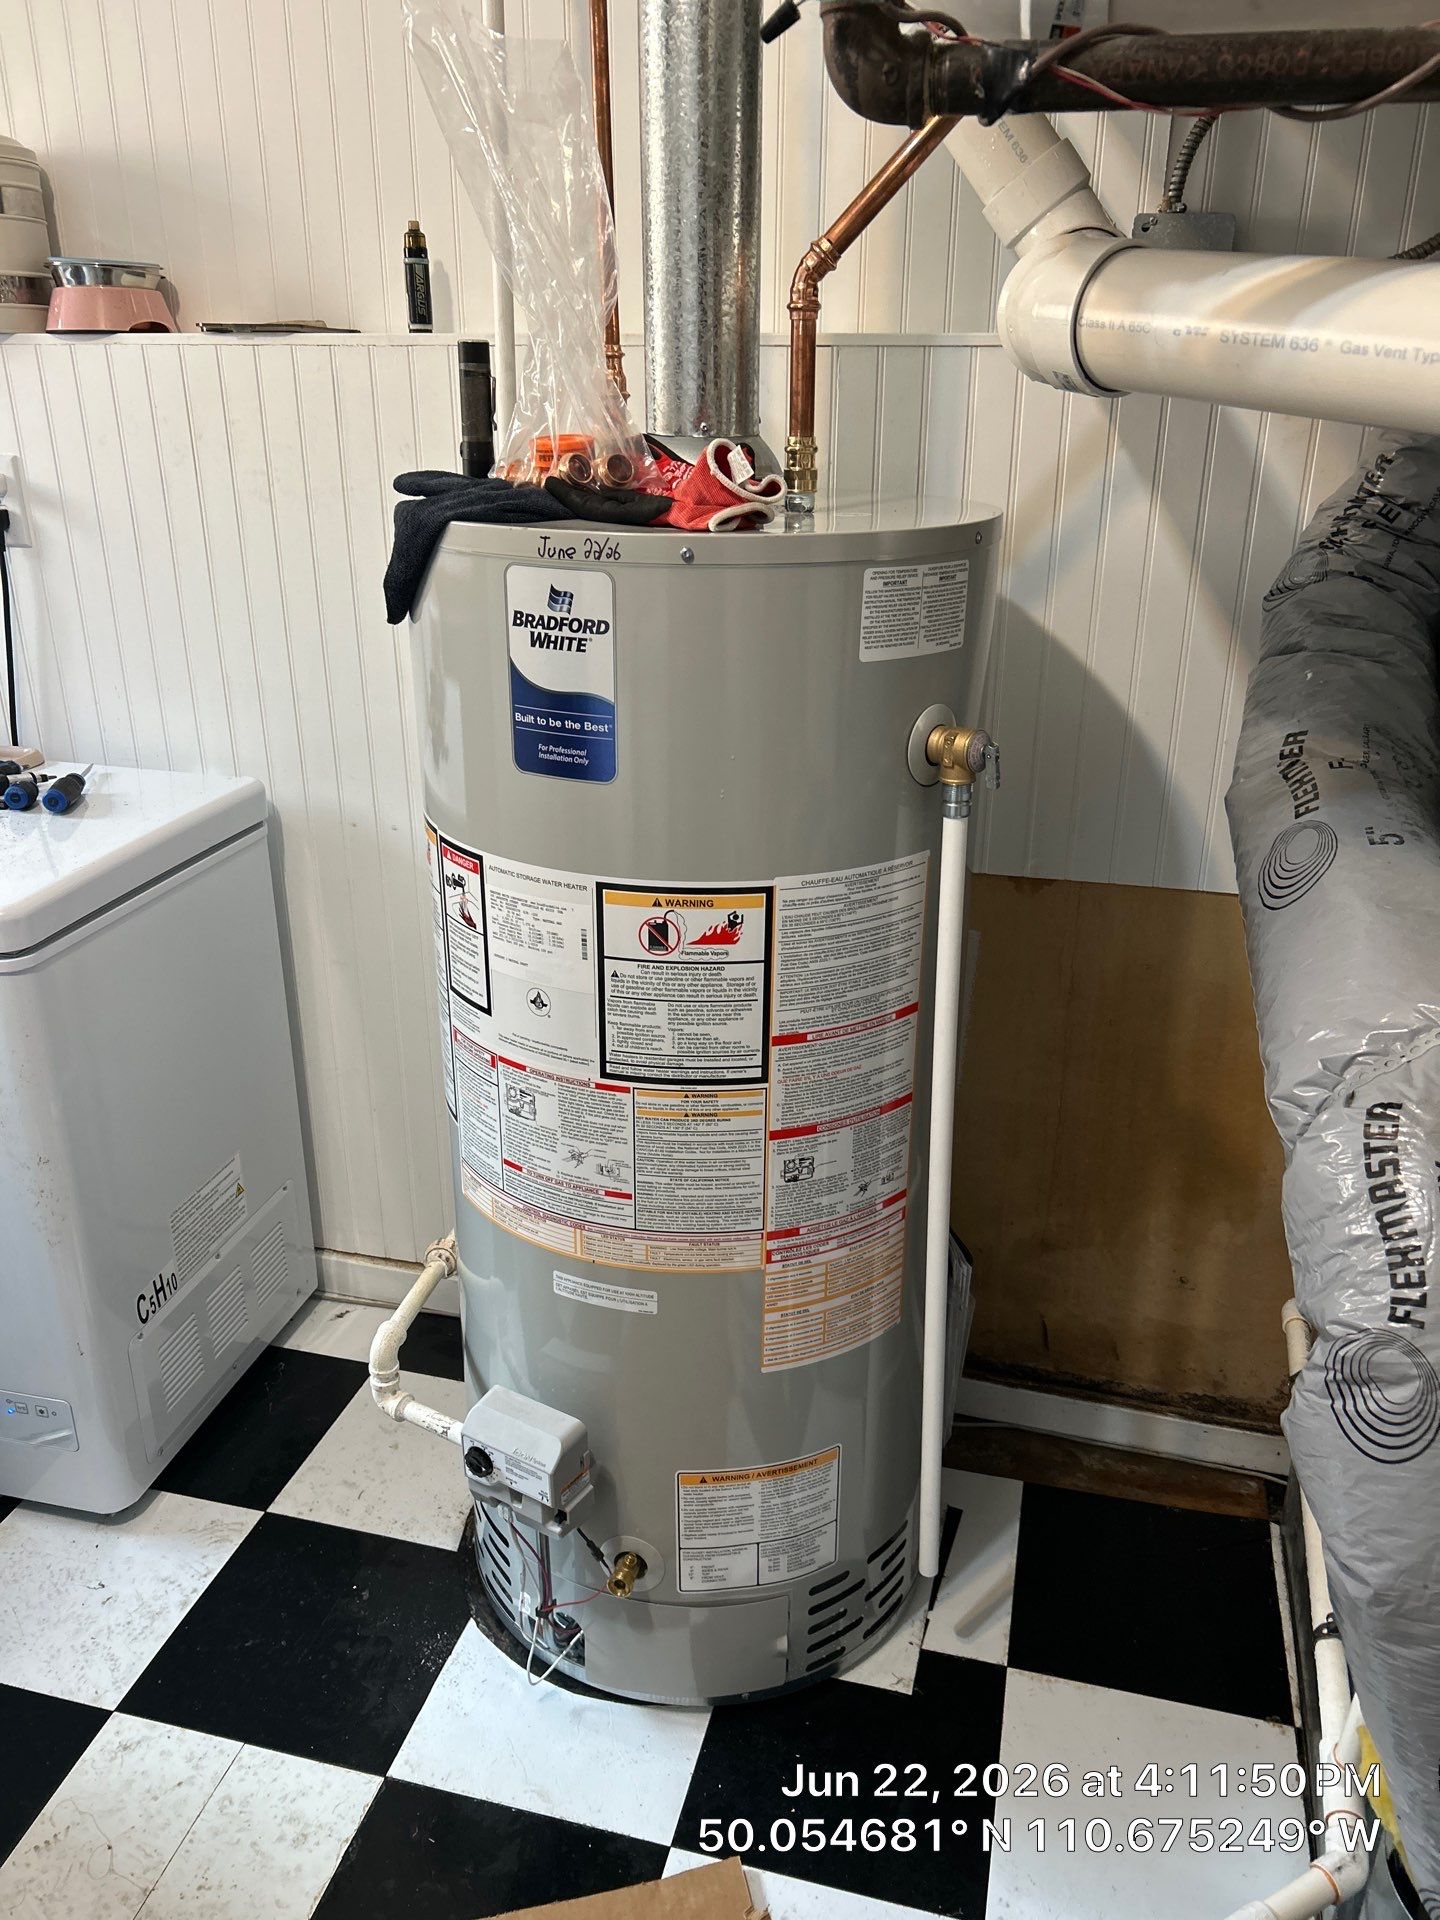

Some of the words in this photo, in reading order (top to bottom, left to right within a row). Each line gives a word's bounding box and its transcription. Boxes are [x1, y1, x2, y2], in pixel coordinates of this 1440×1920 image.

[1011, 140, 1028, 163] 636
[414, 272, 427, 317] ARGUS
[1078, 317, 1105, 329] Class
[1117, 321, 1126, 330] A
[1219, 330, 1285, 349] SYSTEM
[1289, 336, 1319, 352] 636
[1340, 340, 1368, 355] Gas
[1374, 343, 1408, 360] Vent
[538, 536, 576, 559] June
[584, 538, 621, 560] 22/26
[512, 610, 610, 635] BRADFORD
[530, 631, 588, 653] WHITE
[515, 713, 535, 723] Built
[537, 717, 546, 725] to
[549, 718, 561, 727] be
[565, 720, 580, 730] the
[584, 722, 608, 733] Best
[538, 743, 548, 751] For
[549, 745, 587, 756] Professional
[539, 752, 572, 763] Installation
[574, 756, 589, 766] Only
[452, 854, 474, 870] DANGER
[489, 865, 515, 878] AUTOMATIC
[516, 873, 541, 884] STORAGE
[542, 878, 562, 887] WATER
[563, 882, 588, 891] HEATER
[801, 876, 844, 886] CHAUFFE-EAU
[845, 870, 882, 881] AUTOMATIQUE
[665, 899, 714, 908] WARNING
[529, 1068, 554, 1080] OPERATING
[555, 1076, 591, 1088] INSTRUCTIONS
[533, 1171, 544, 1179] TURN
[555, 1179, 563, 1187] GAS
[571, 1183, 599, 1194] APPLIANCE
[1362, 1101, 1427, 1330] FLEXMASTER
[712, 1473, 750, 1482] WARNING
[756, 1459, 818, 1479] AVERTISSEMENT
